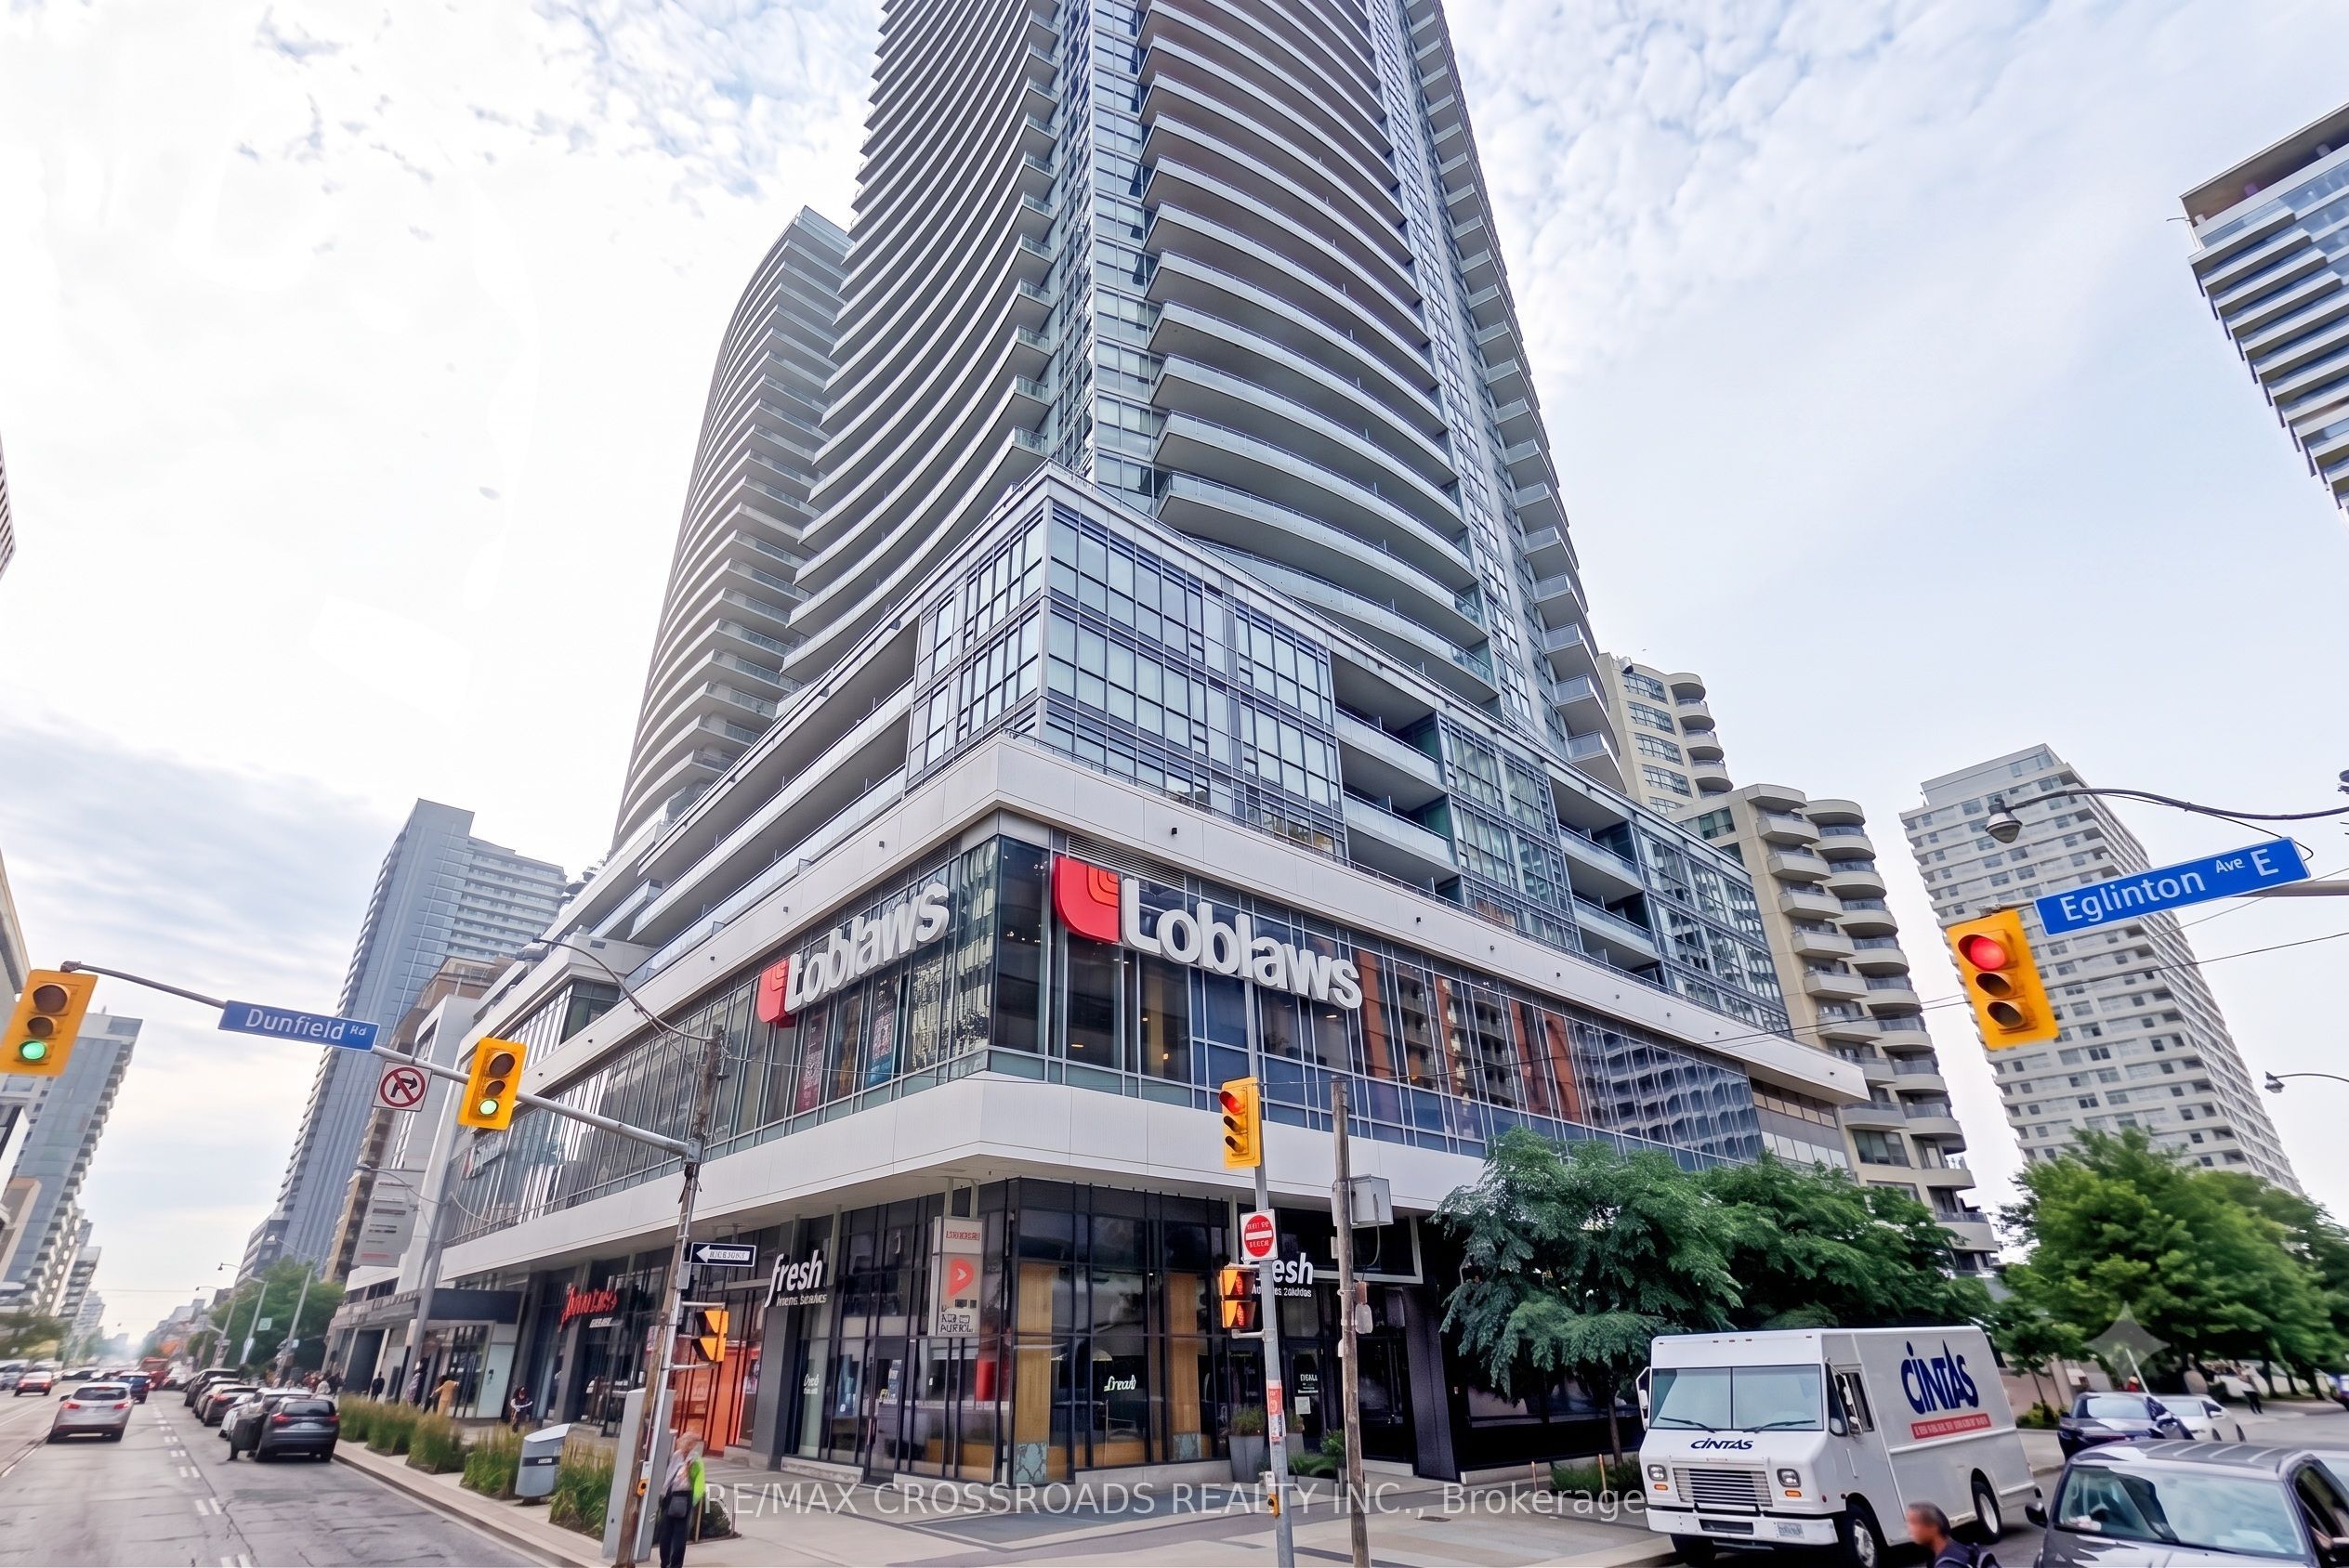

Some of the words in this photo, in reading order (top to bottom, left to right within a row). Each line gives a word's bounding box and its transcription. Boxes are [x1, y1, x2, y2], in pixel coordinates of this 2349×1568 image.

[2059, 871, 2206, 922] Eglinton
[2215, 856, 2245, 873] Ave
[2251, 848, 2279, 877] E
[784, 882, 950, 1014] Loblaws
[1121, 877, 1363, 1011] Loblaws
[244, 1008, 347, 1040] Dunfield
[349, 1025, 368, 1037] Rd
[764, 1249, 823, 1308] fresh
[1900, 1339, 1979, 1415] CINTAS
[1690, 1437, 1754, 1450] CINTAS
